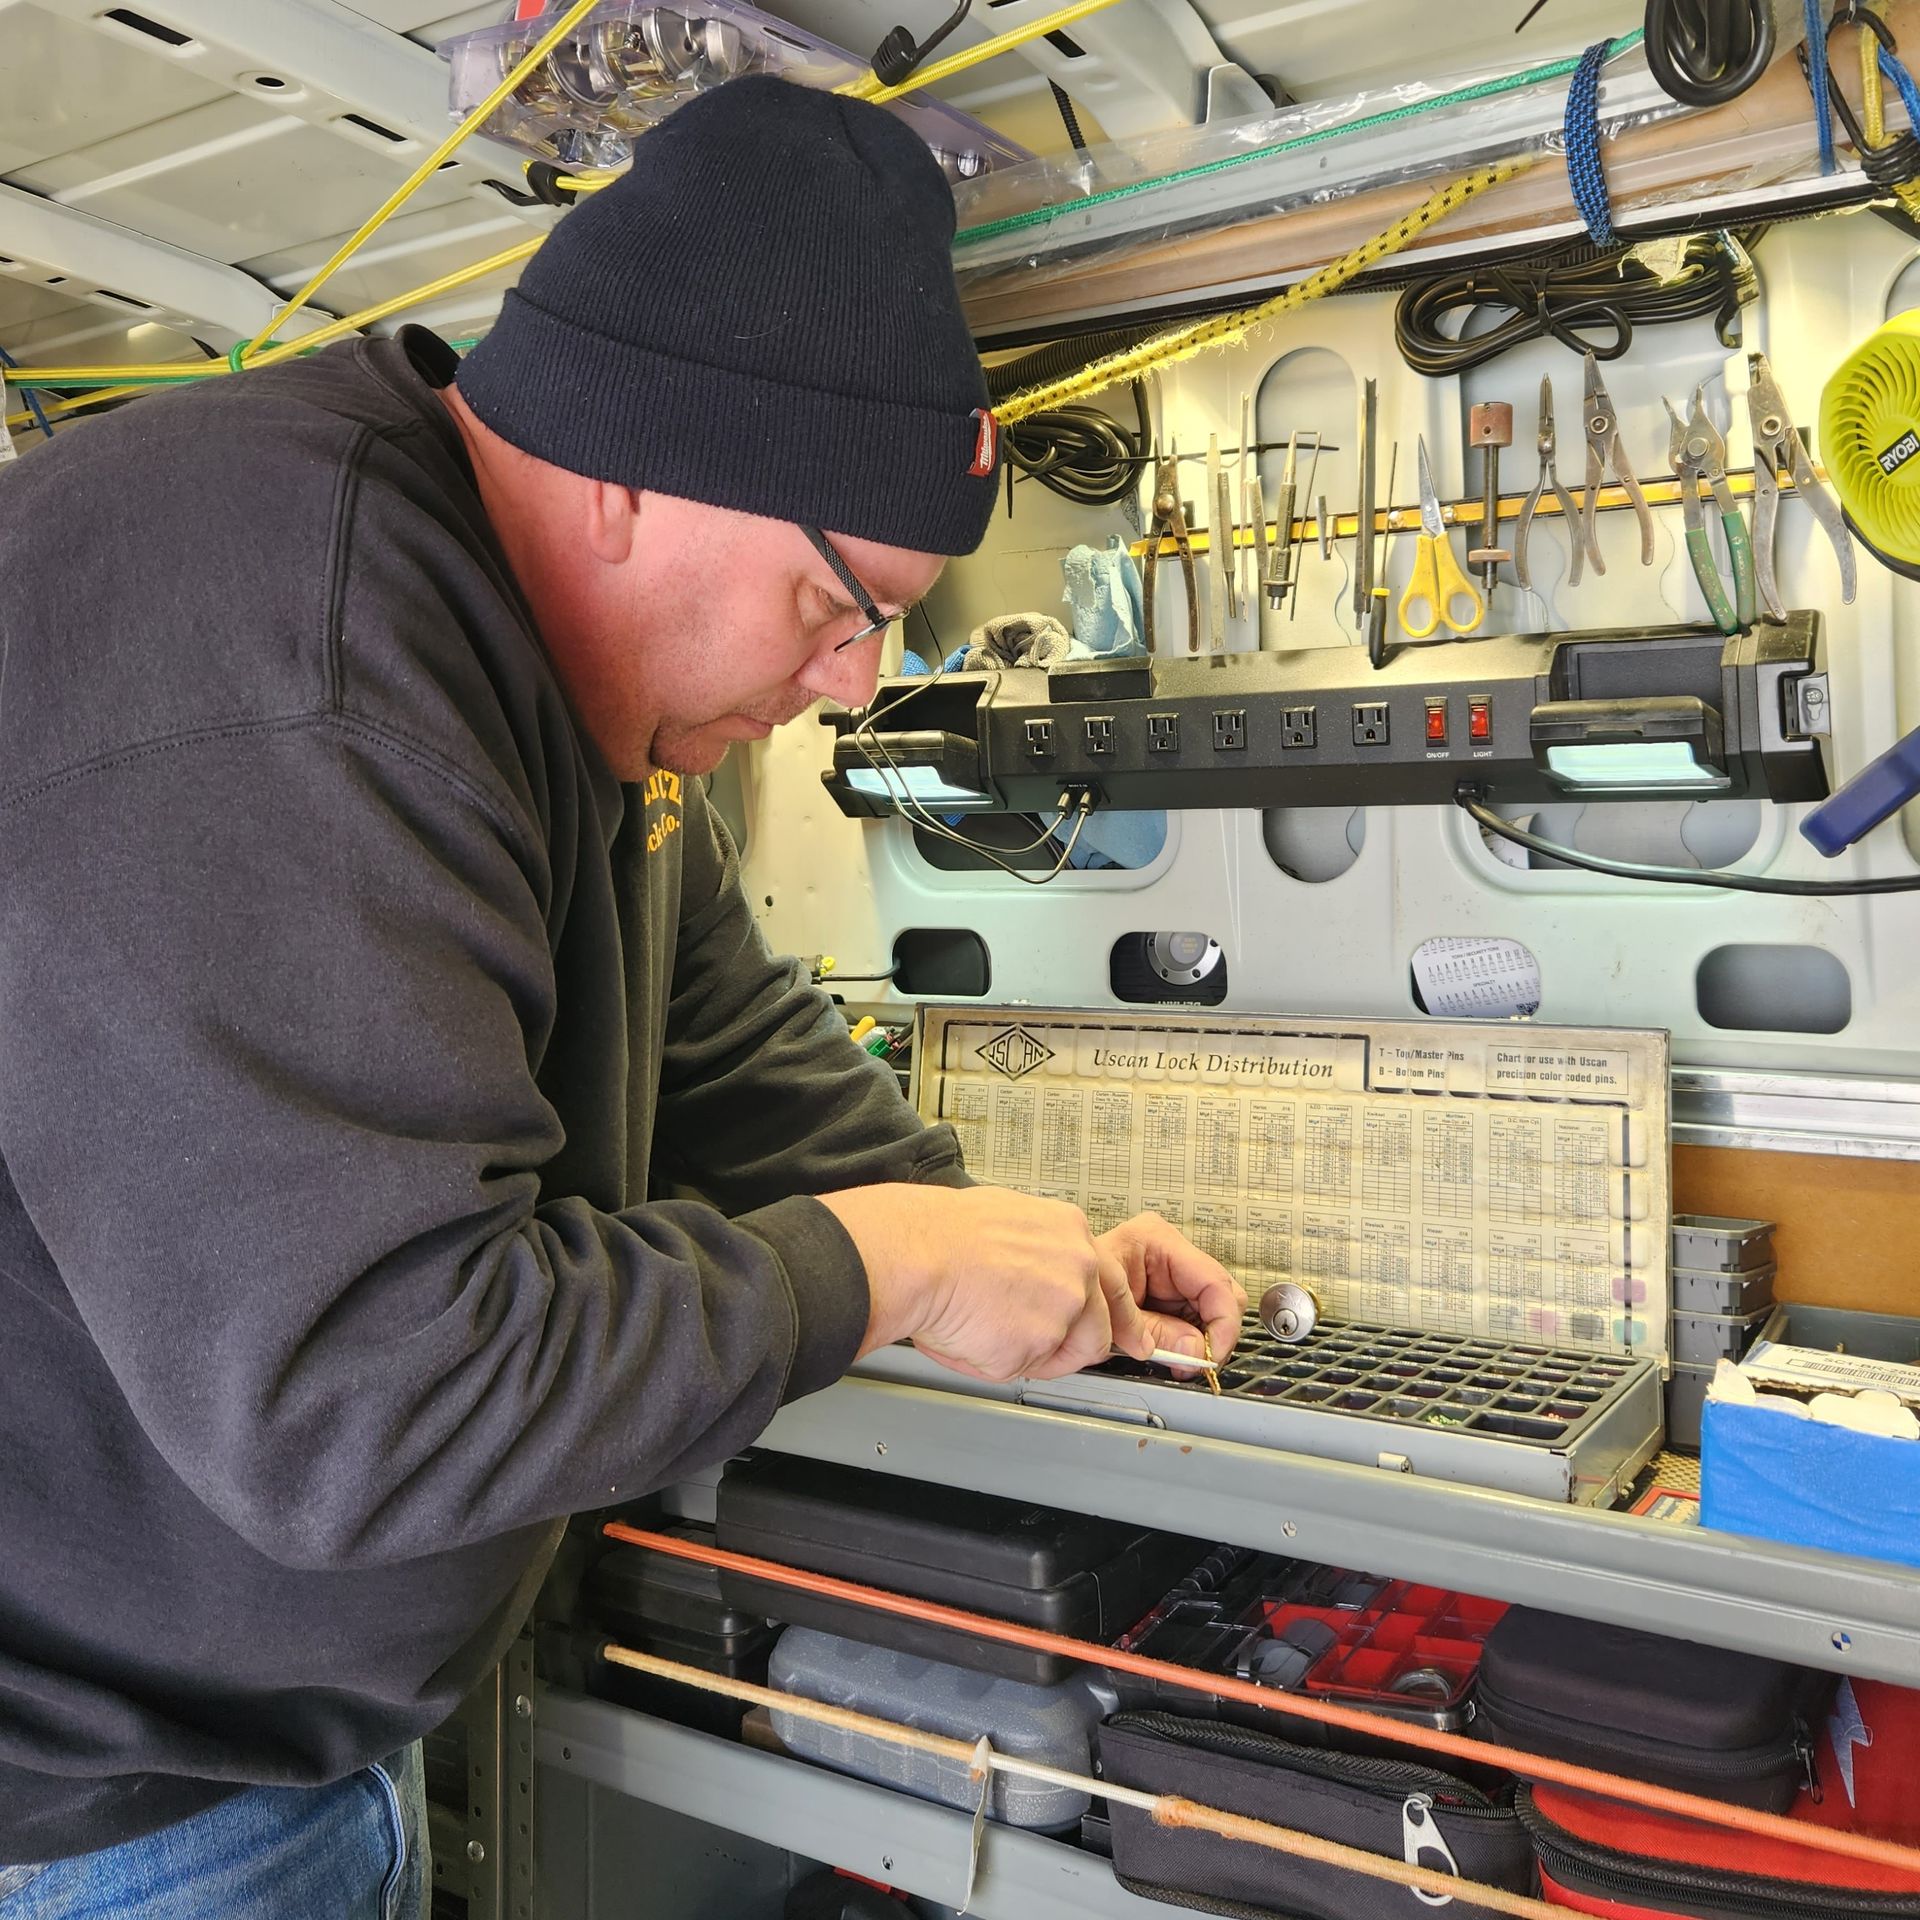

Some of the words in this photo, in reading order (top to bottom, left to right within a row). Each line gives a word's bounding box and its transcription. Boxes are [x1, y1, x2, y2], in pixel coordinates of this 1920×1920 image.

[1879, 433, 1920, 472] RYOBI
[1379, 1047, 1385, 1057] T
[1496, 1052, 1521, 1063] Chart
[1538, 1055, 1554, 1065] use
[1557, 1055, 1576, 1066] wth
[1579, 1056, 1607, 1067] Uscan
[1094, 1048, 1149, 1068] Uscan
[1155, 1051, 1201, 1071] Lock
[1206, 1053, 1333, 1078] Distribution
[1427, 1068, 1446, 1079] Pins
[1496, 1069, 1537, 1080] precision
[1539, 1071, 1563, 1081] color
[1594, 1074, 1617, 1085] pins.
[1824, 1357, 1920, 1377] SC1-BR-250
